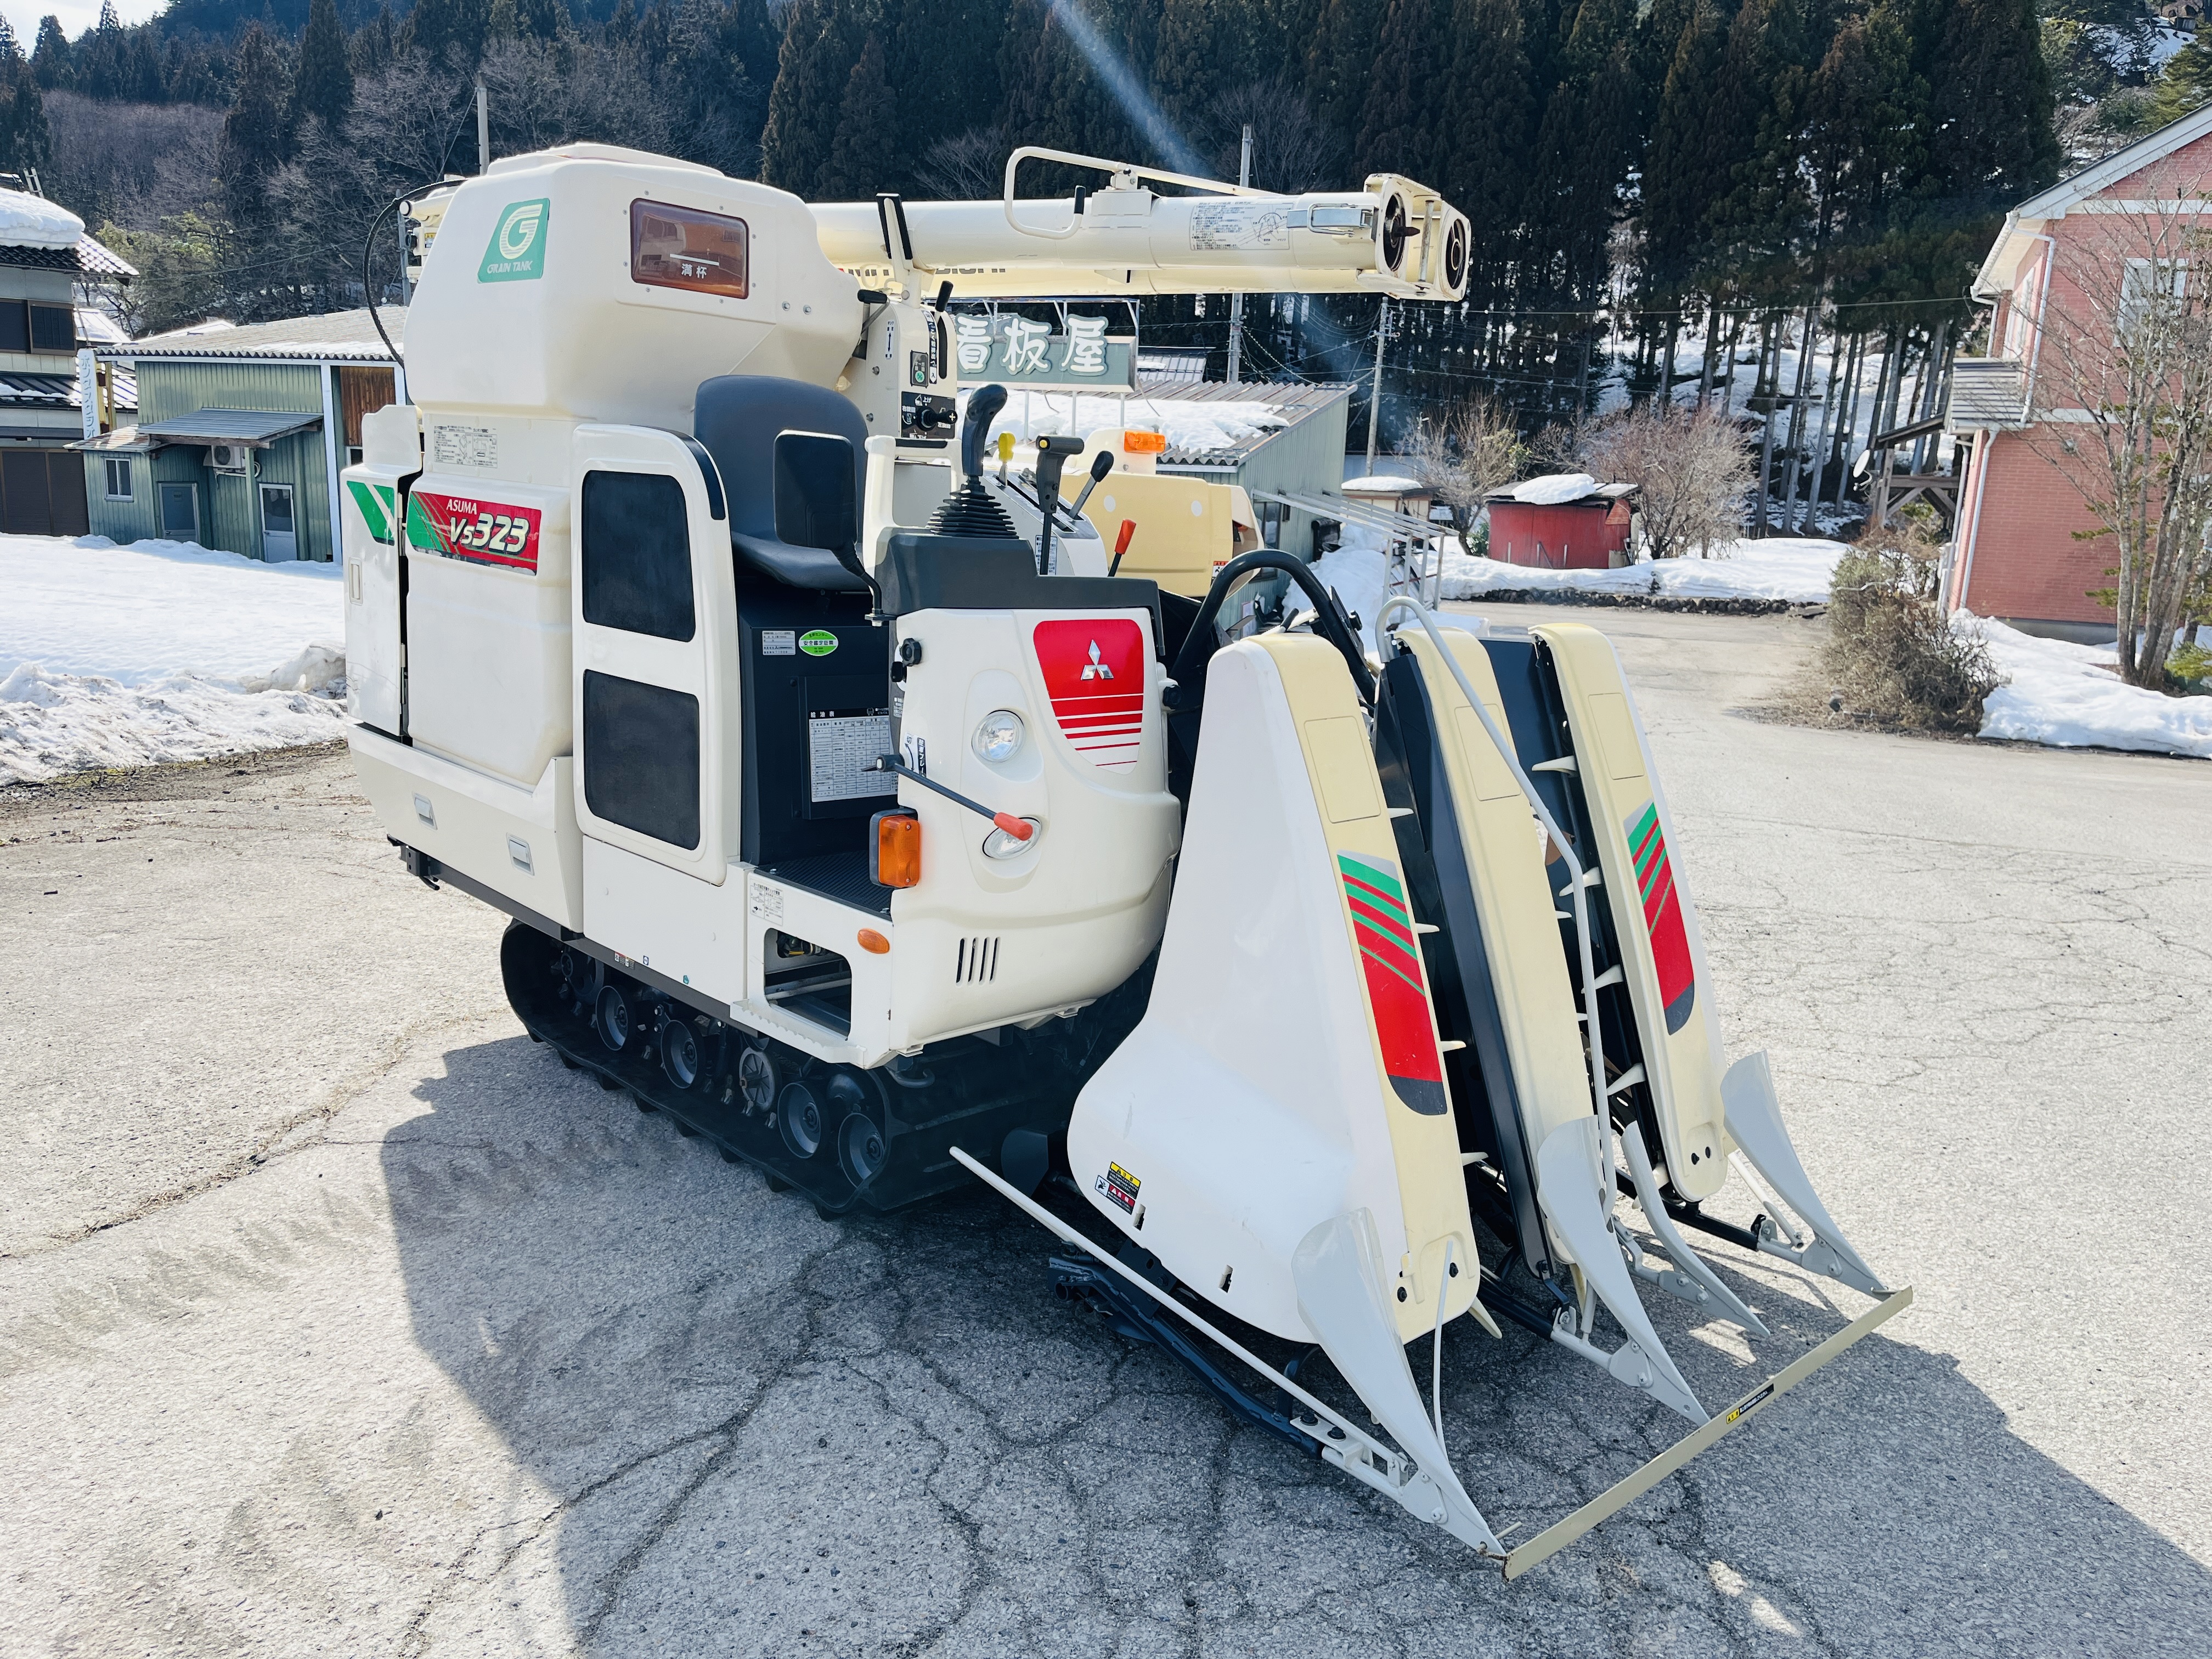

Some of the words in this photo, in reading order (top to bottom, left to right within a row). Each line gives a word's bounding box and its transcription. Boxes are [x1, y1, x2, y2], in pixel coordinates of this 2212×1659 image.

[487, 262, 511, 274] GRAIN
[513, 260, 533, 272] TANK
[681, 263, 707, 279] 満杯
[957, 315, 1106, 373] 看板屋
[446, 499, 477, 515] ASUMA
